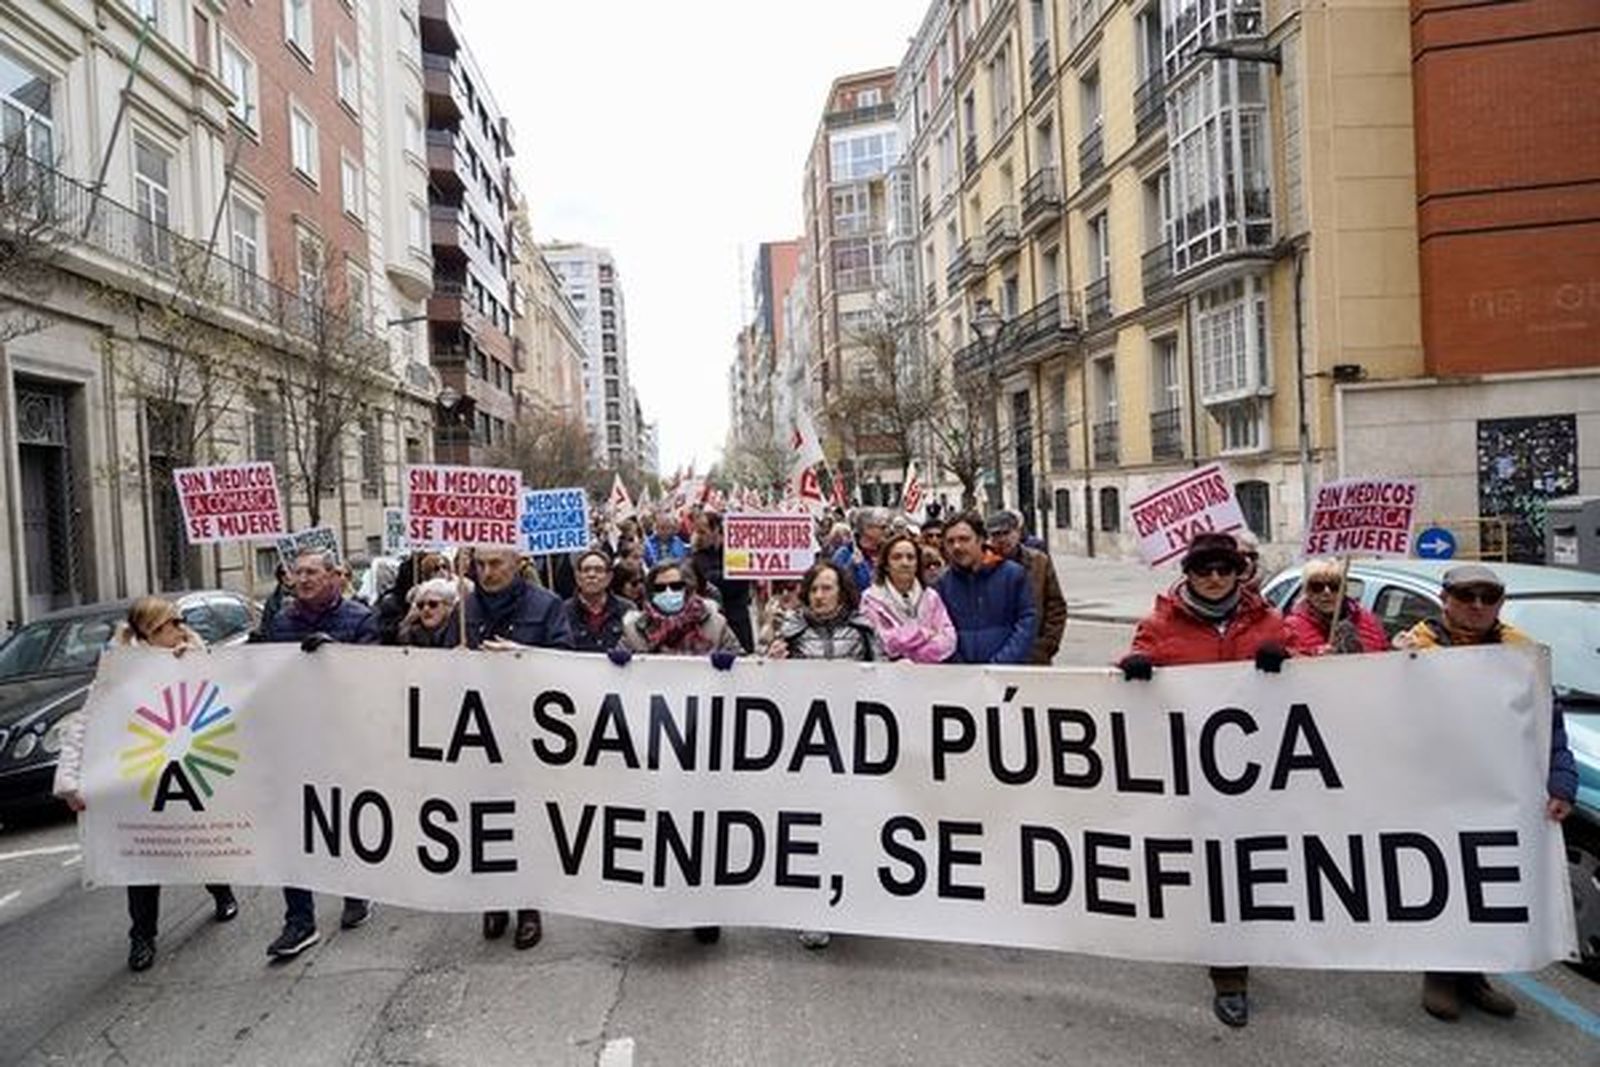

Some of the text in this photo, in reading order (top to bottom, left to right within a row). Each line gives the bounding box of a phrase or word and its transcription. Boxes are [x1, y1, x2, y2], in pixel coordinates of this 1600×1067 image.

[180, 466, 273, 494] SIN MEDICOS
[409, 468, 518, 496] SIN MEDICOS
[411, 495, 516, 519] LA COMARCA
[525, 490, 583, 512] MEDICOS
[1132, 473, 1230, 539] ESPECIALISTAS
[1316, 482, 1416, 509] SIN MEDICOS
[190, 513, 282, 539] SE MUERE
[409, 519, 433, 540] SE
[442, 520, 517, 545] MUERE
[1312, 507, 1409, 531] LA COMARCA
[528, 530, 587, 551] MUERE
[727, 523, 812, 550] ESPECIALISTAS
[1306, 530, 1408, 554] SE MUERE
[748, 552, 791, 570] ¡YA!
[407, 686, 1344, 797] LA SANIDAD PÚBLICA
[303, 783, 1531, 925] NO SE VENDE, SE DEFIENDE
